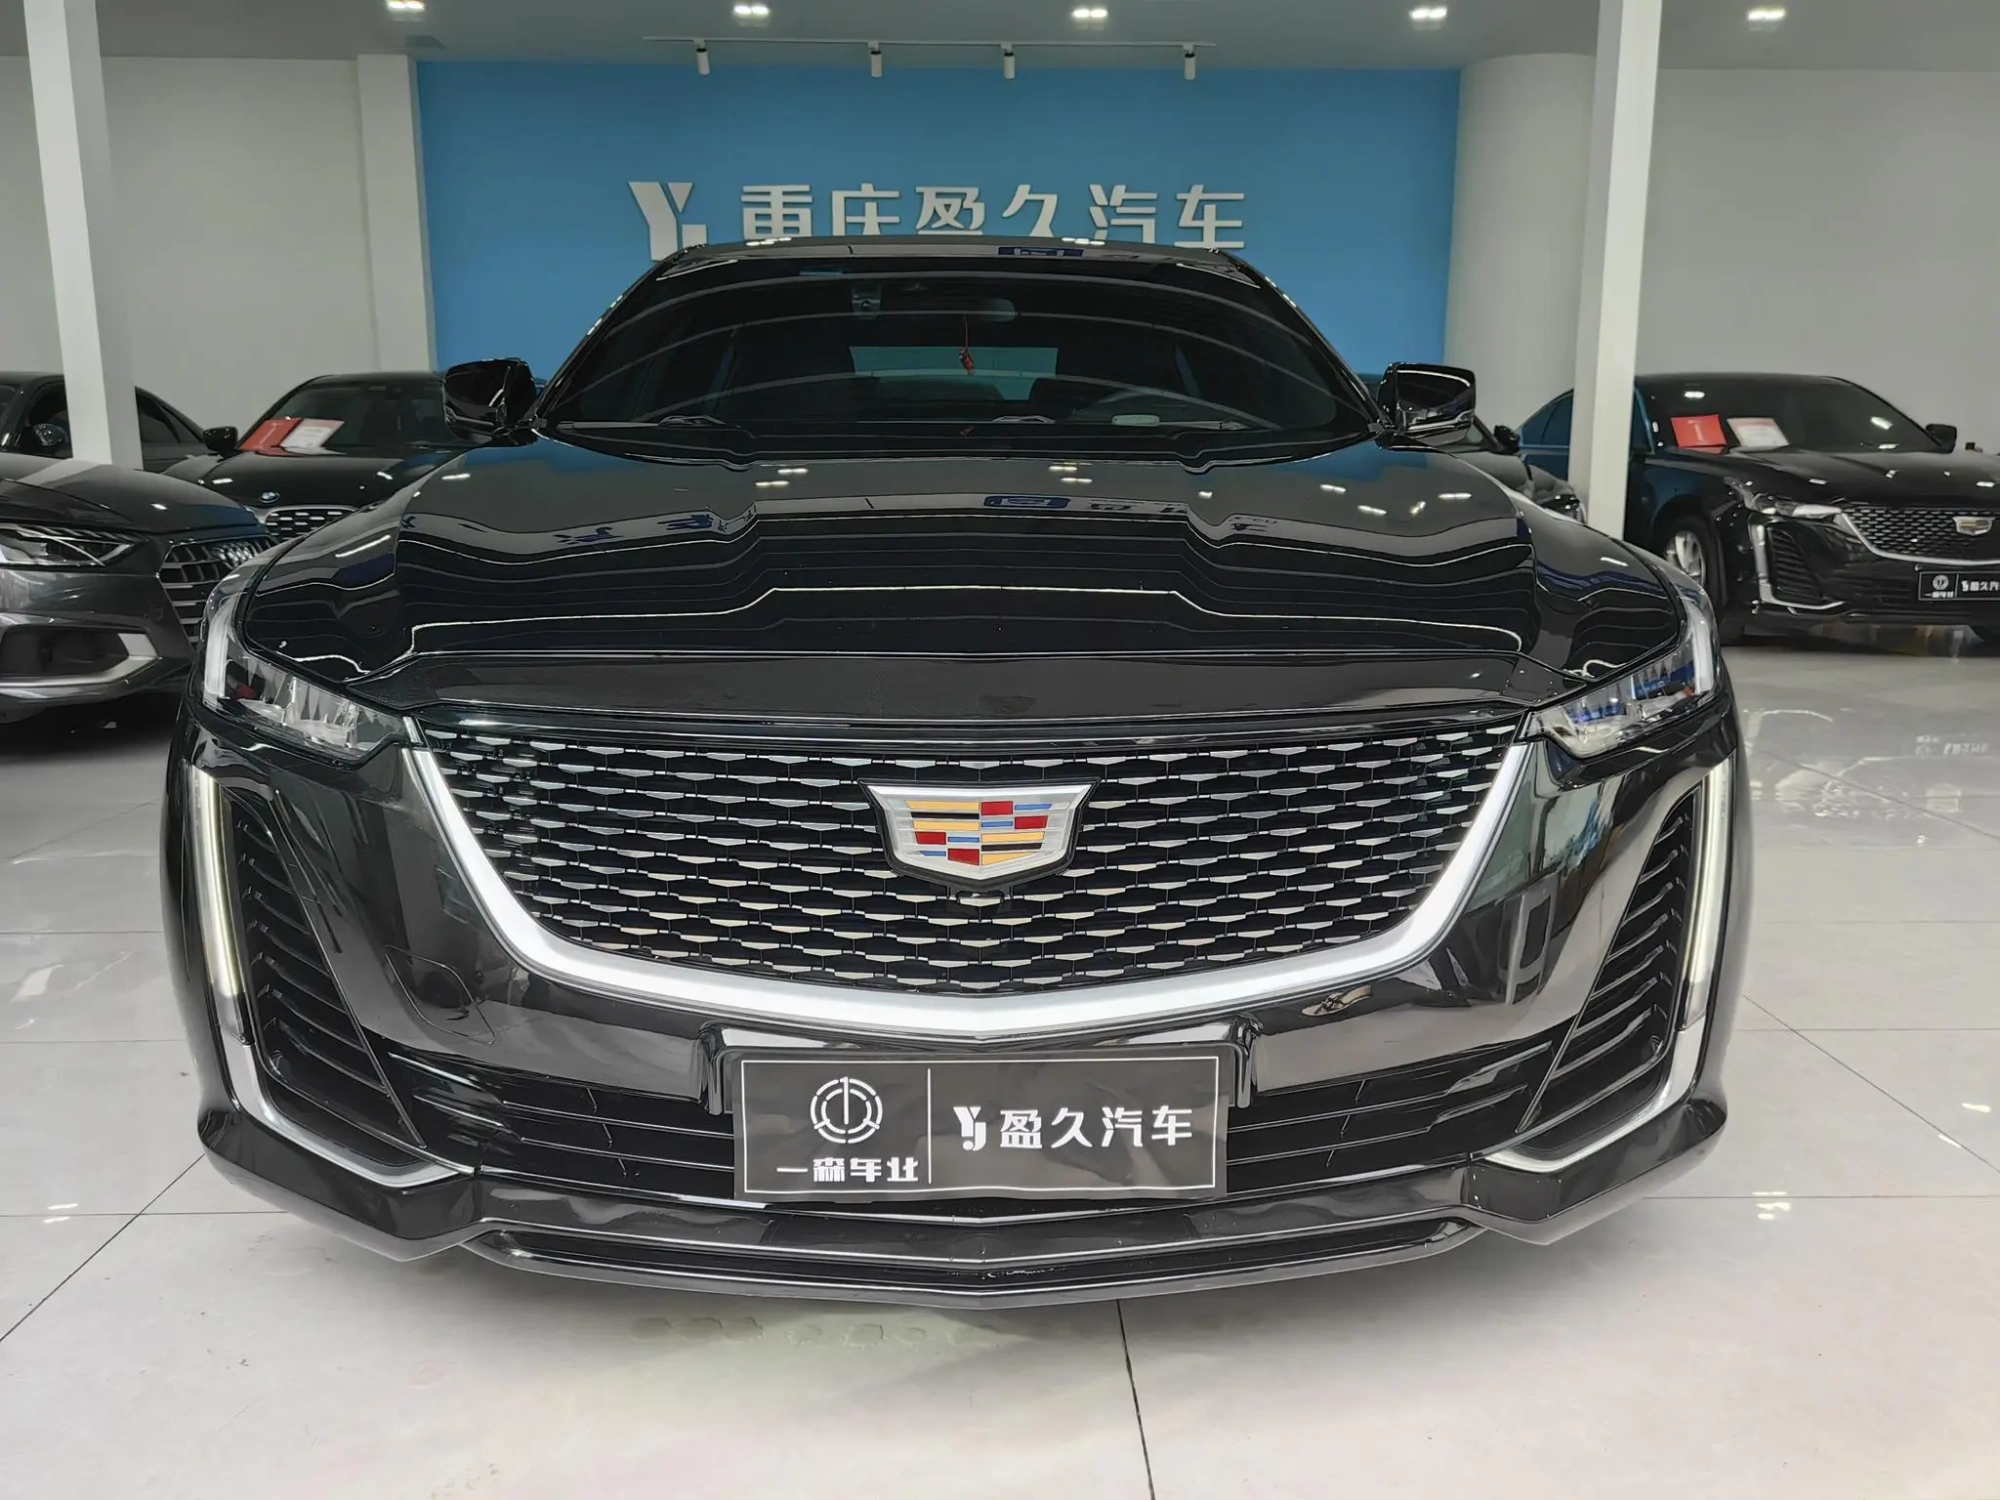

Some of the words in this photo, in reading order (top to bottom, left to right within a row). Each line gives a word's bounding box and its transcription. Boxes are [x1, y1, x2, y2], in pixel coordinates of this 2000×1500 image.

[741, 183, 1244, 248] 重庆盈久汽车
[1000, 1105, 1193, 1149] 盈久汽车
